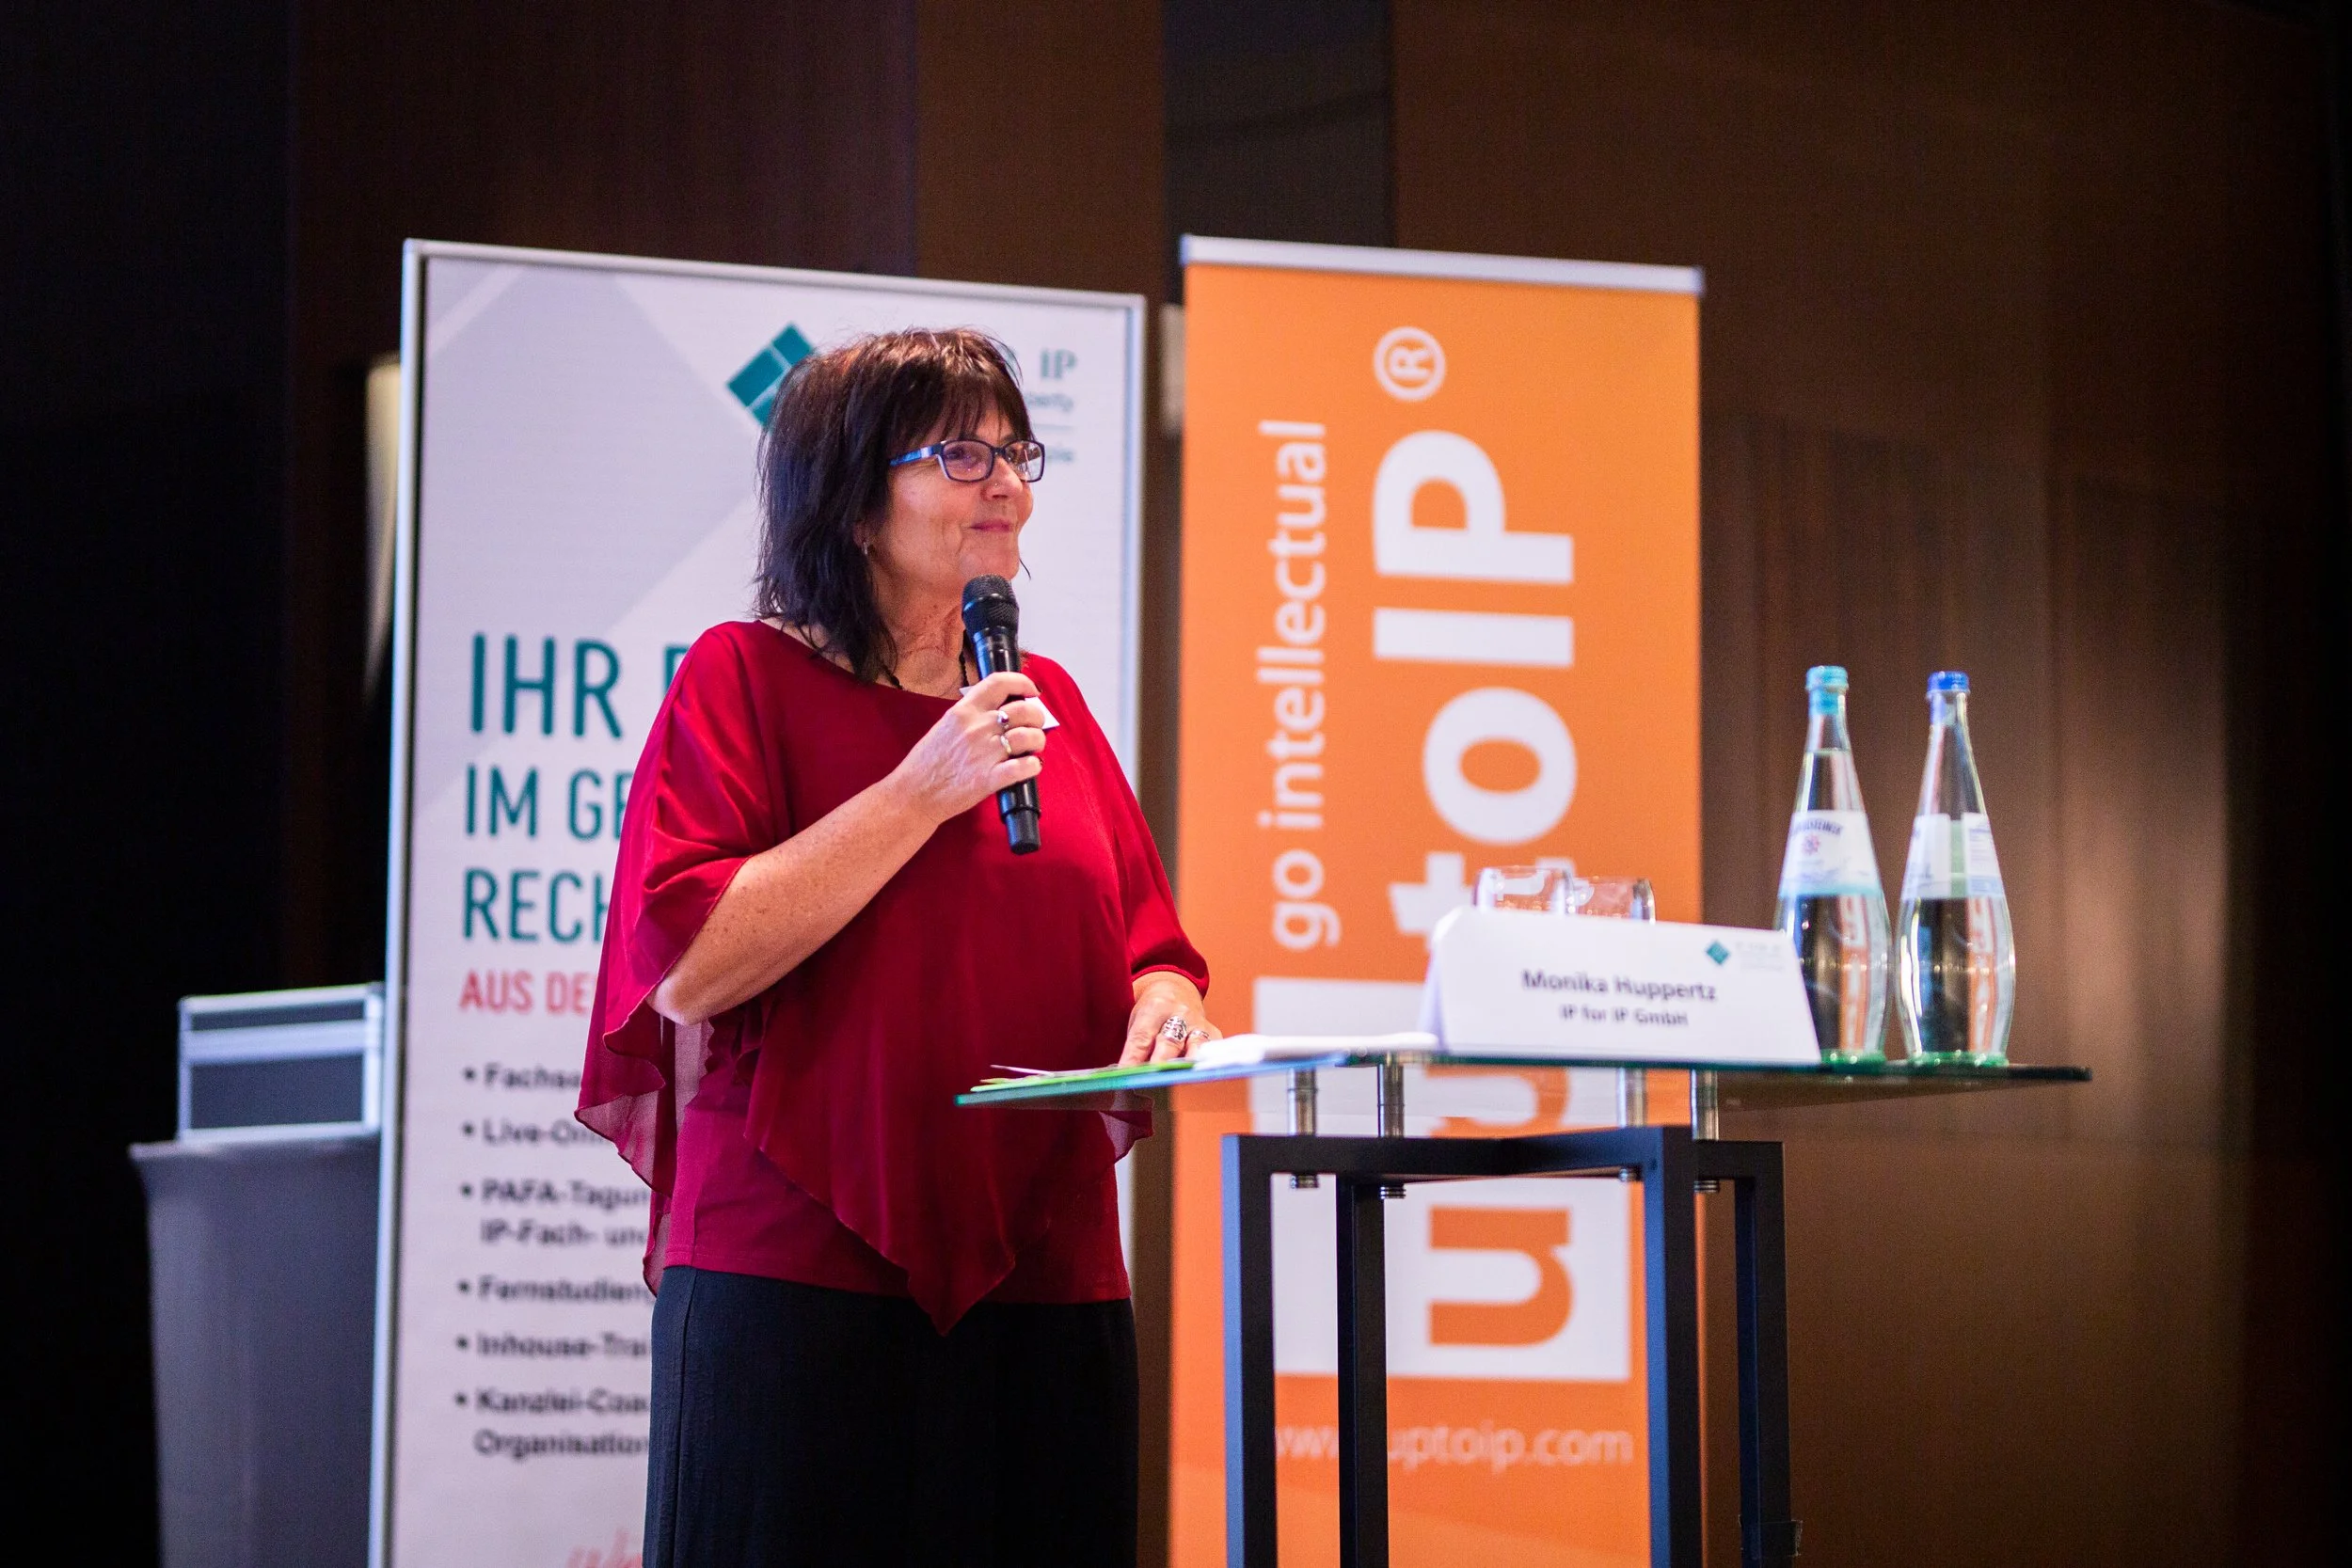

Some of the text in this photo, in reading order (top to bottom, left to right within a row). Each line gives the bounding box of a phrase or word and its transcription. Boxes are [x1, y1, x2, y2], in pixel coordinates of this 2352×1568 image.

[1040, 348, 1077, 379] IP
[470, 631, 623, 739] IHR
[1257, 420, 1342, 952] go intellectual
[467, 765, 537, 836] IM
[459, 970, 596, 1015] AUS DE
[1521, 970, 1717, 1001] Monika Huppertz
[1561, 1004, 1578, 1021] IP
[1582, 1005, 1607, 1021] for
[1613, 1006, 1629, 1022] IP
